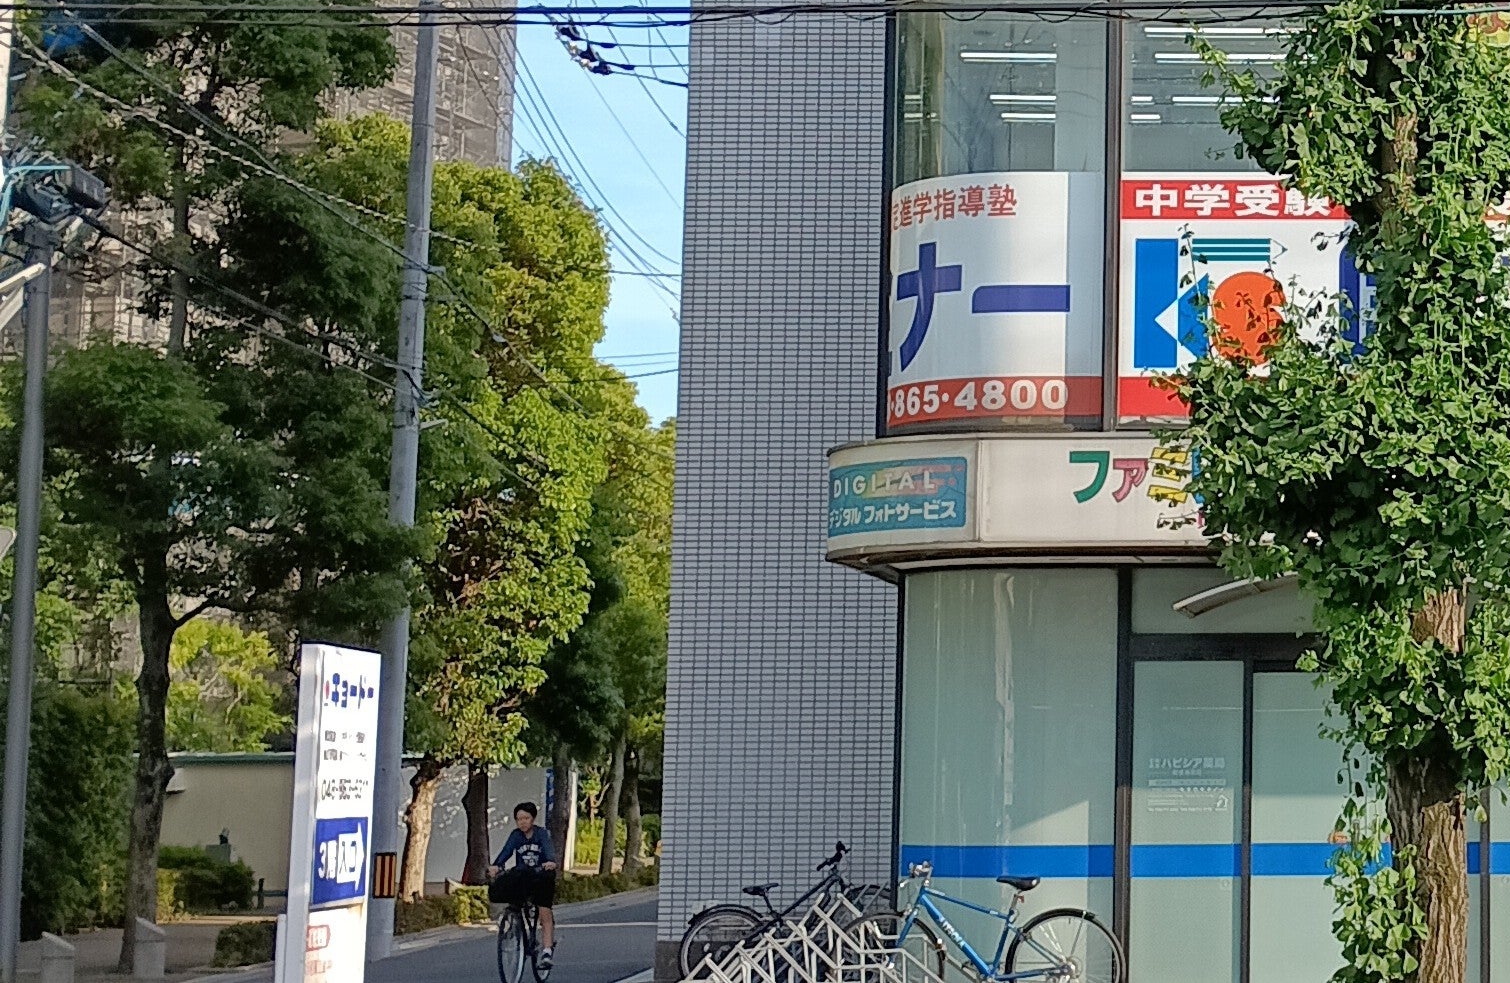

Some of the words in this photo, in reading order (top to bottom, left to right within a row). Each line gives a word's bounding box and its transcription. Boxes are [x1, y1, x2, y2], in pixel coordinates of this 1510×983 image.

[833, 470, 935, 498] DIGITAL
[1069, 447, 1206, 506] ファミ
